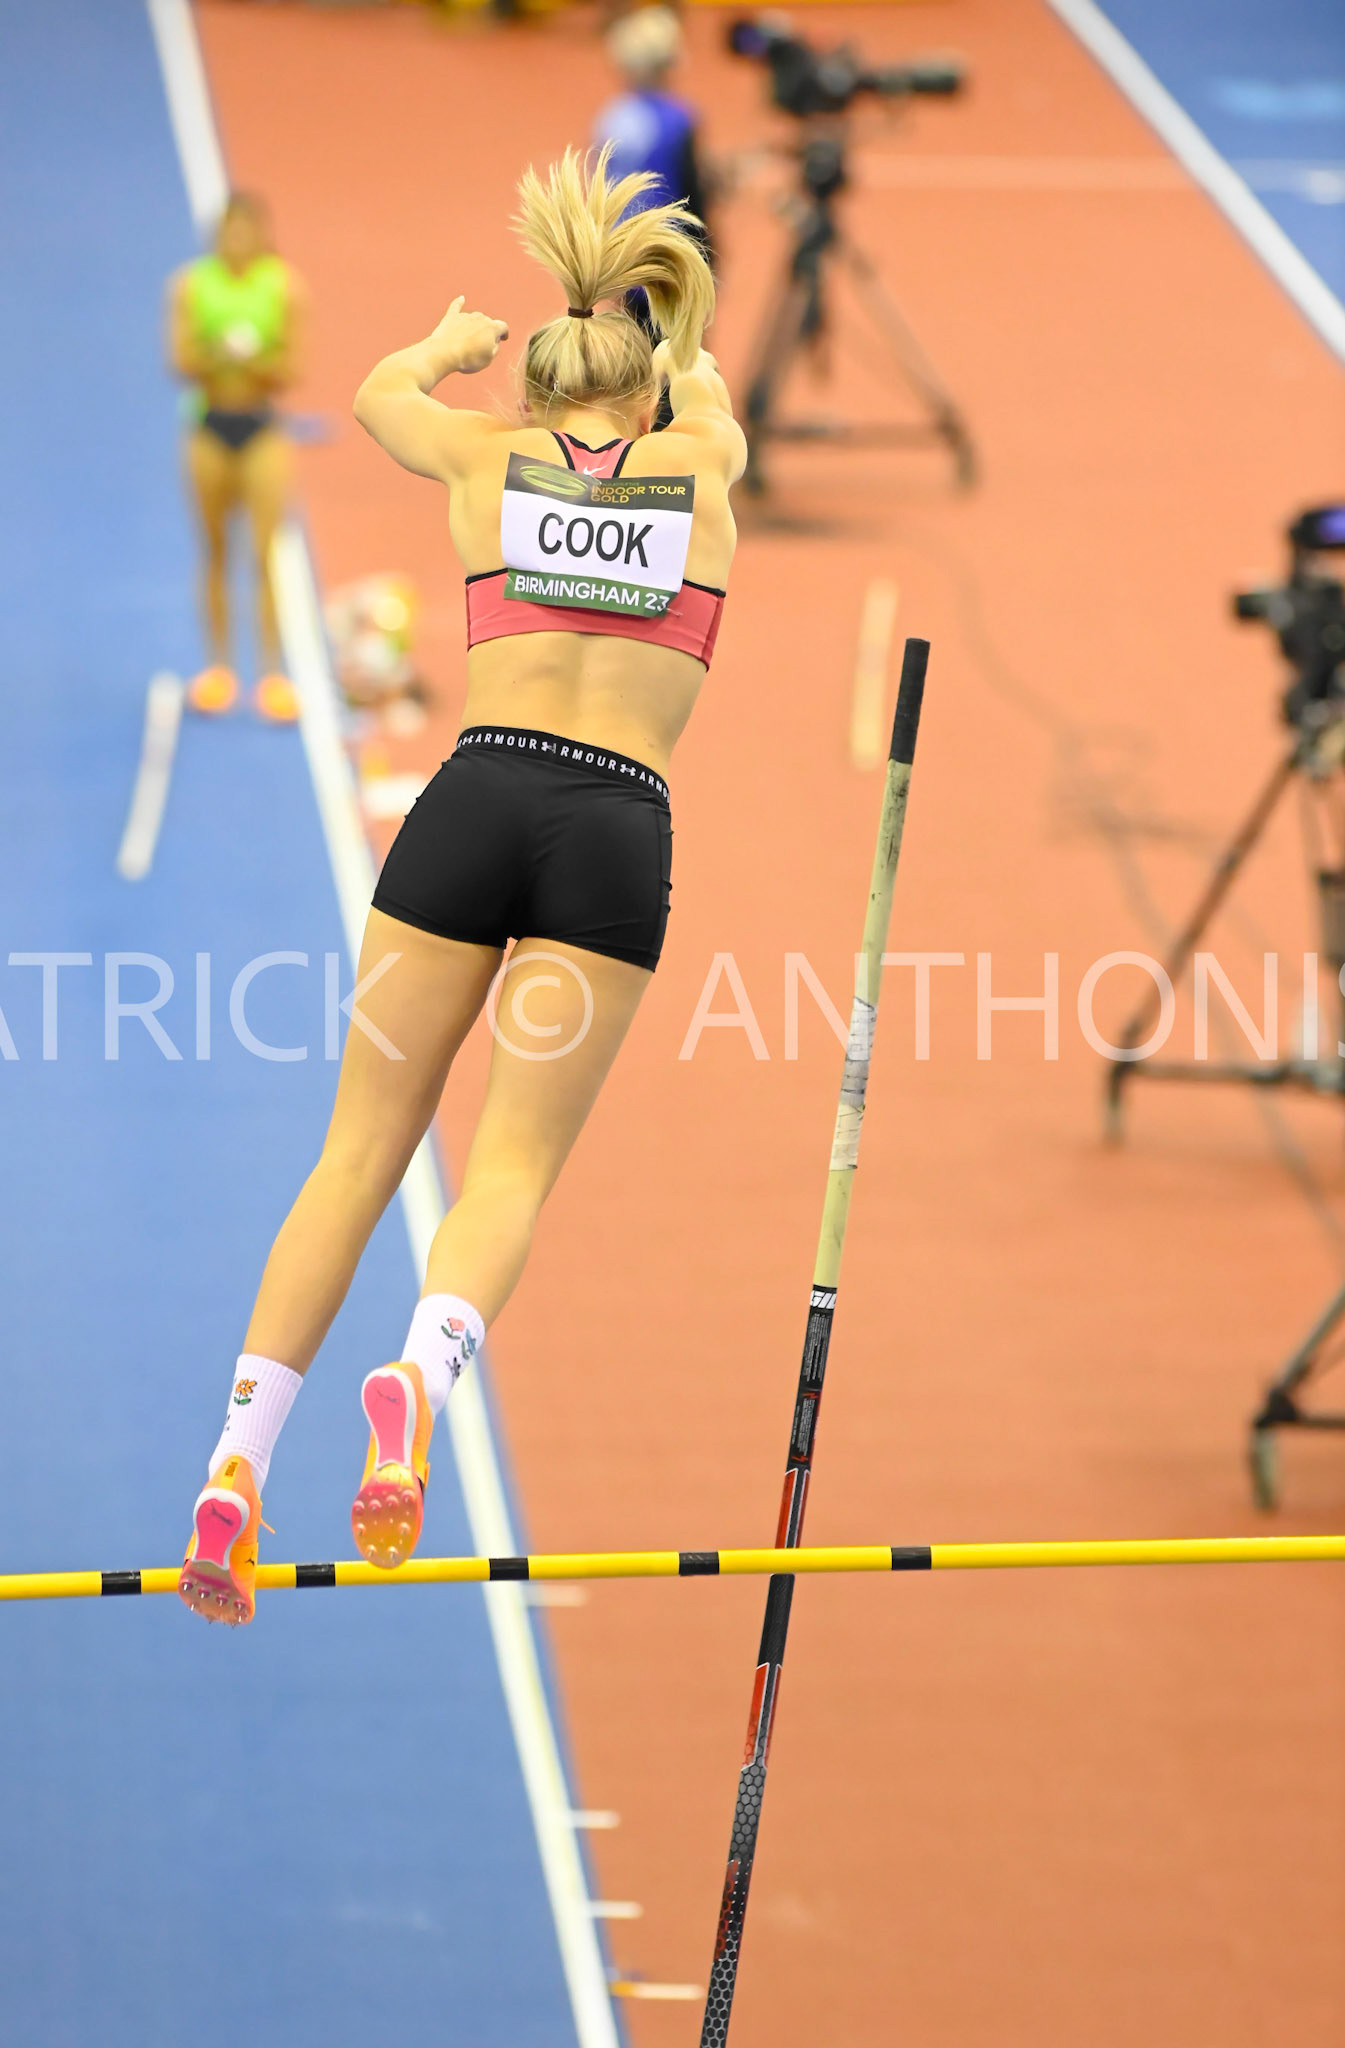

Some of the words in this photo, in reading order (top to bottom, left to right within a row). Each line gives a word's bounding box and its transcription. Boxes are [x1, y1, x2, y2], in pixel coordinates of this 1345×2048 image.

[591, 484, 646, 496] INDOOR
[648, 485, 686, 496] TOUR
[590, 494, 630, 504] GOLD
[538, 512, 654, 568] COOK
[514, 574, 640, 607] BIRMINGHAM
[644, 592, 670, 612] 23
[474, 733, 538, 750] ARMOUR
